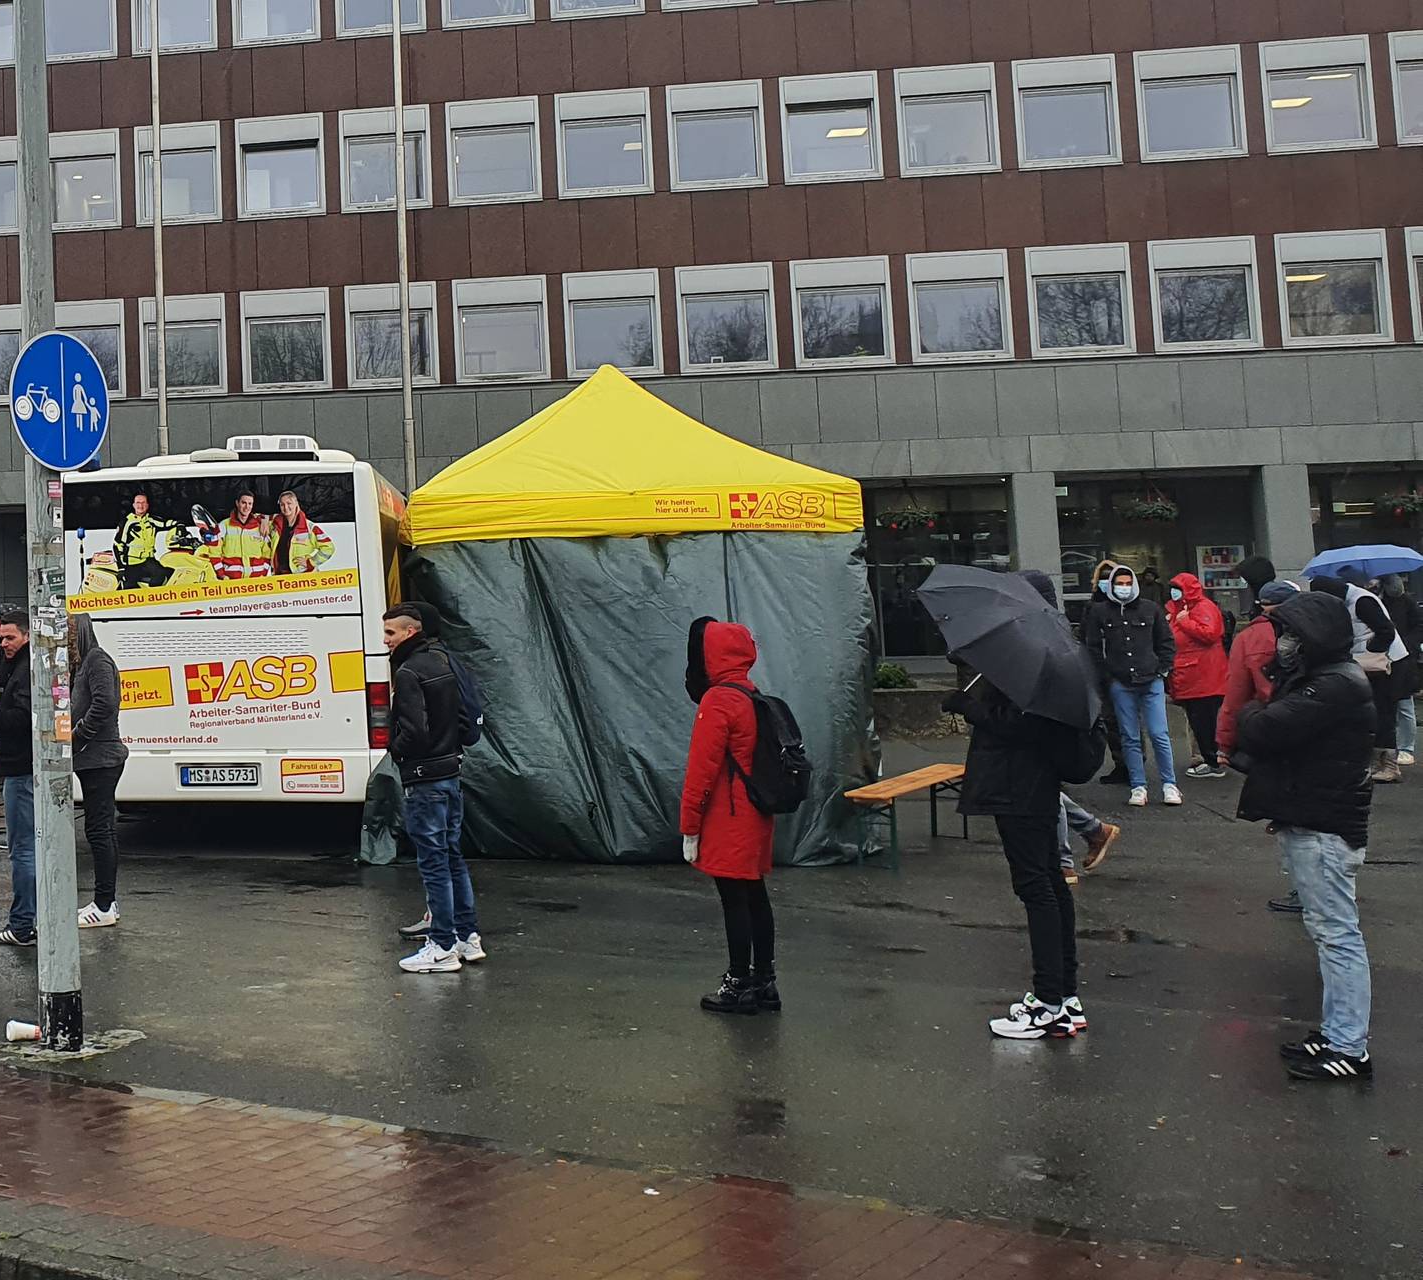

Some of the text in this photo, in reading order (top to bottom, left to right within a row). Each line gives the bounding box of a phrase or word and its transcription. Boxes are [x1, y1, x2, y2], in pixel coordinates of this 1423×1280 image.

[751, 490, 826, 520] ASB
[731, 521, 826, 529] Arbeiter-Samariter-Bund
[69, 573, 353, 609] Möchtest Du auch ein Teil unseres Teams sein?
[209, 593, 353, 615] teamplayer@asb-muenster.de
[120, 679, 140, 689] fen
[215, 654, 318, 702] ASB
[133, 690, 163, 703] jetzt.
[189, 700, 321, 719] Arbeiter-Samariter-Bund
[189, 711, 324, 729] Regionalverband Münsterland e.V.
[121, 735, 219, 744] sb-muensterland.de
[212, 769, 226, 782] AS
[228, 769, 256, 782] 5731
